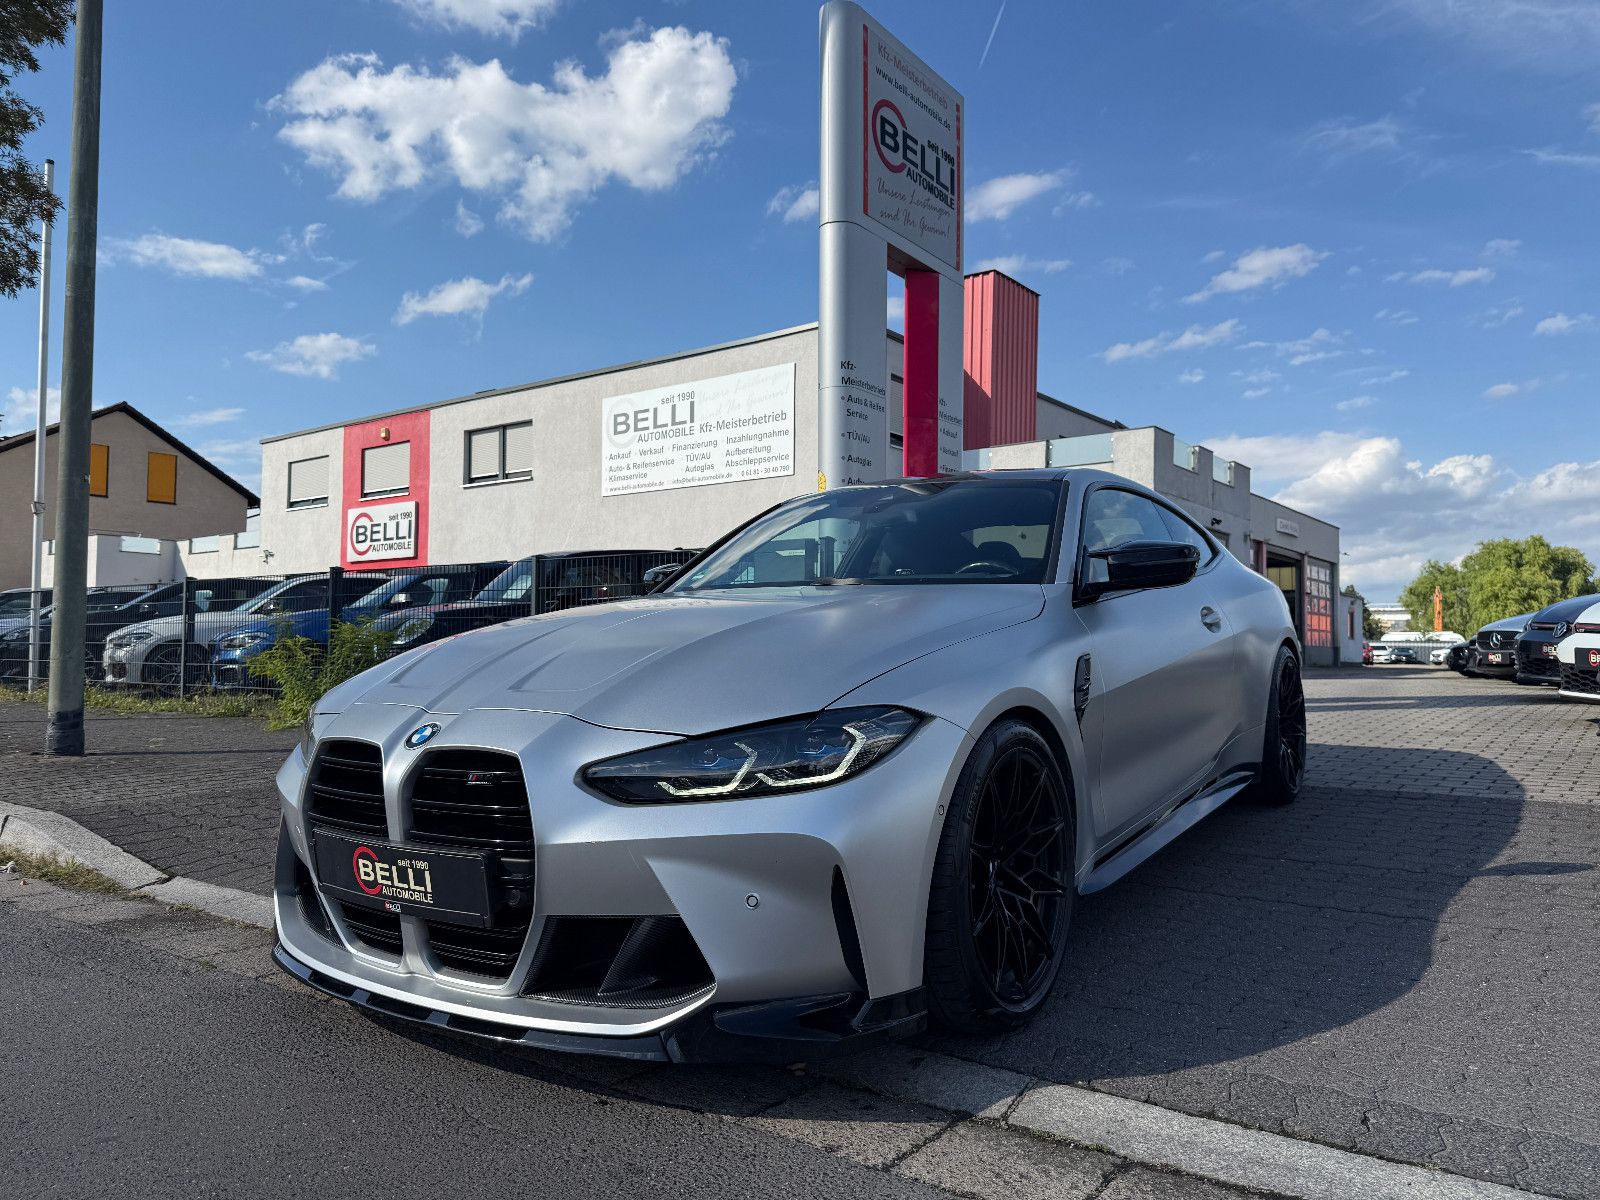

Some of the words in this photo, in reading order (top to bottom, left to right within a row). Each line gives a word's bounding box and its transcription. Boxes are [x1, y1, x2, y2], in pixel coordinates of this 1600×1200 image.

[878, 42, 948, 109] Kfz-Meisterbetrieb
[875, 65, 951, 131] www.belli-automobile.de
[880, 115, 955, 196] BELLI
[927, 139, 939, 156] seit
[941, 148, 954, 167] 1990
[906, 167, 955, 210] AUTOMOBILE
[840, 361, 856, 371] Kfz-
[661, 395, 675, 405] seit
[678, 391, 695, 402] 1990
[841, 377, 886, 396] Meisterbetrieb
[613, 400, 695, 436] BELLI
[699, 410, 787, 433] Kfz-Meisterbetrieb
[846, 409, 868, 421] Service
[609, 450, 632, 461] Ankauf
[639, 446, 664, 456] Verkauf
[672, 440, 718, 452] Finanzierung
[726, 429, 789, 444] Inzahlungnahme
[637, 426, 695, 443] AUTOMOBILE
[609, 464, 625, 473] Auto-
[633, 459, 675, 470] Reifenservice
[686, 452, 711, 462] TÜV/AU
[725, 445, 771, 457] Aufbereitung
[609, 472, 648, 483] Klimaservice
[685, 463, 715, 473] Autoglas
[725, 453, 789, 468] Abschleppservice
[389, 513, 399, 521] seit
[400, 511, 413, 520] 1990
[355, 520, 412, 544] BELLI
[372, 541, 412, 552] AUTOMOBILE
[358, 858, 432, 893] BELLI
[397, 859, 410, 867] seit
[412, 860, 429, 870] 1990
[382, 886, 434, 904] AUTOMOBILE
